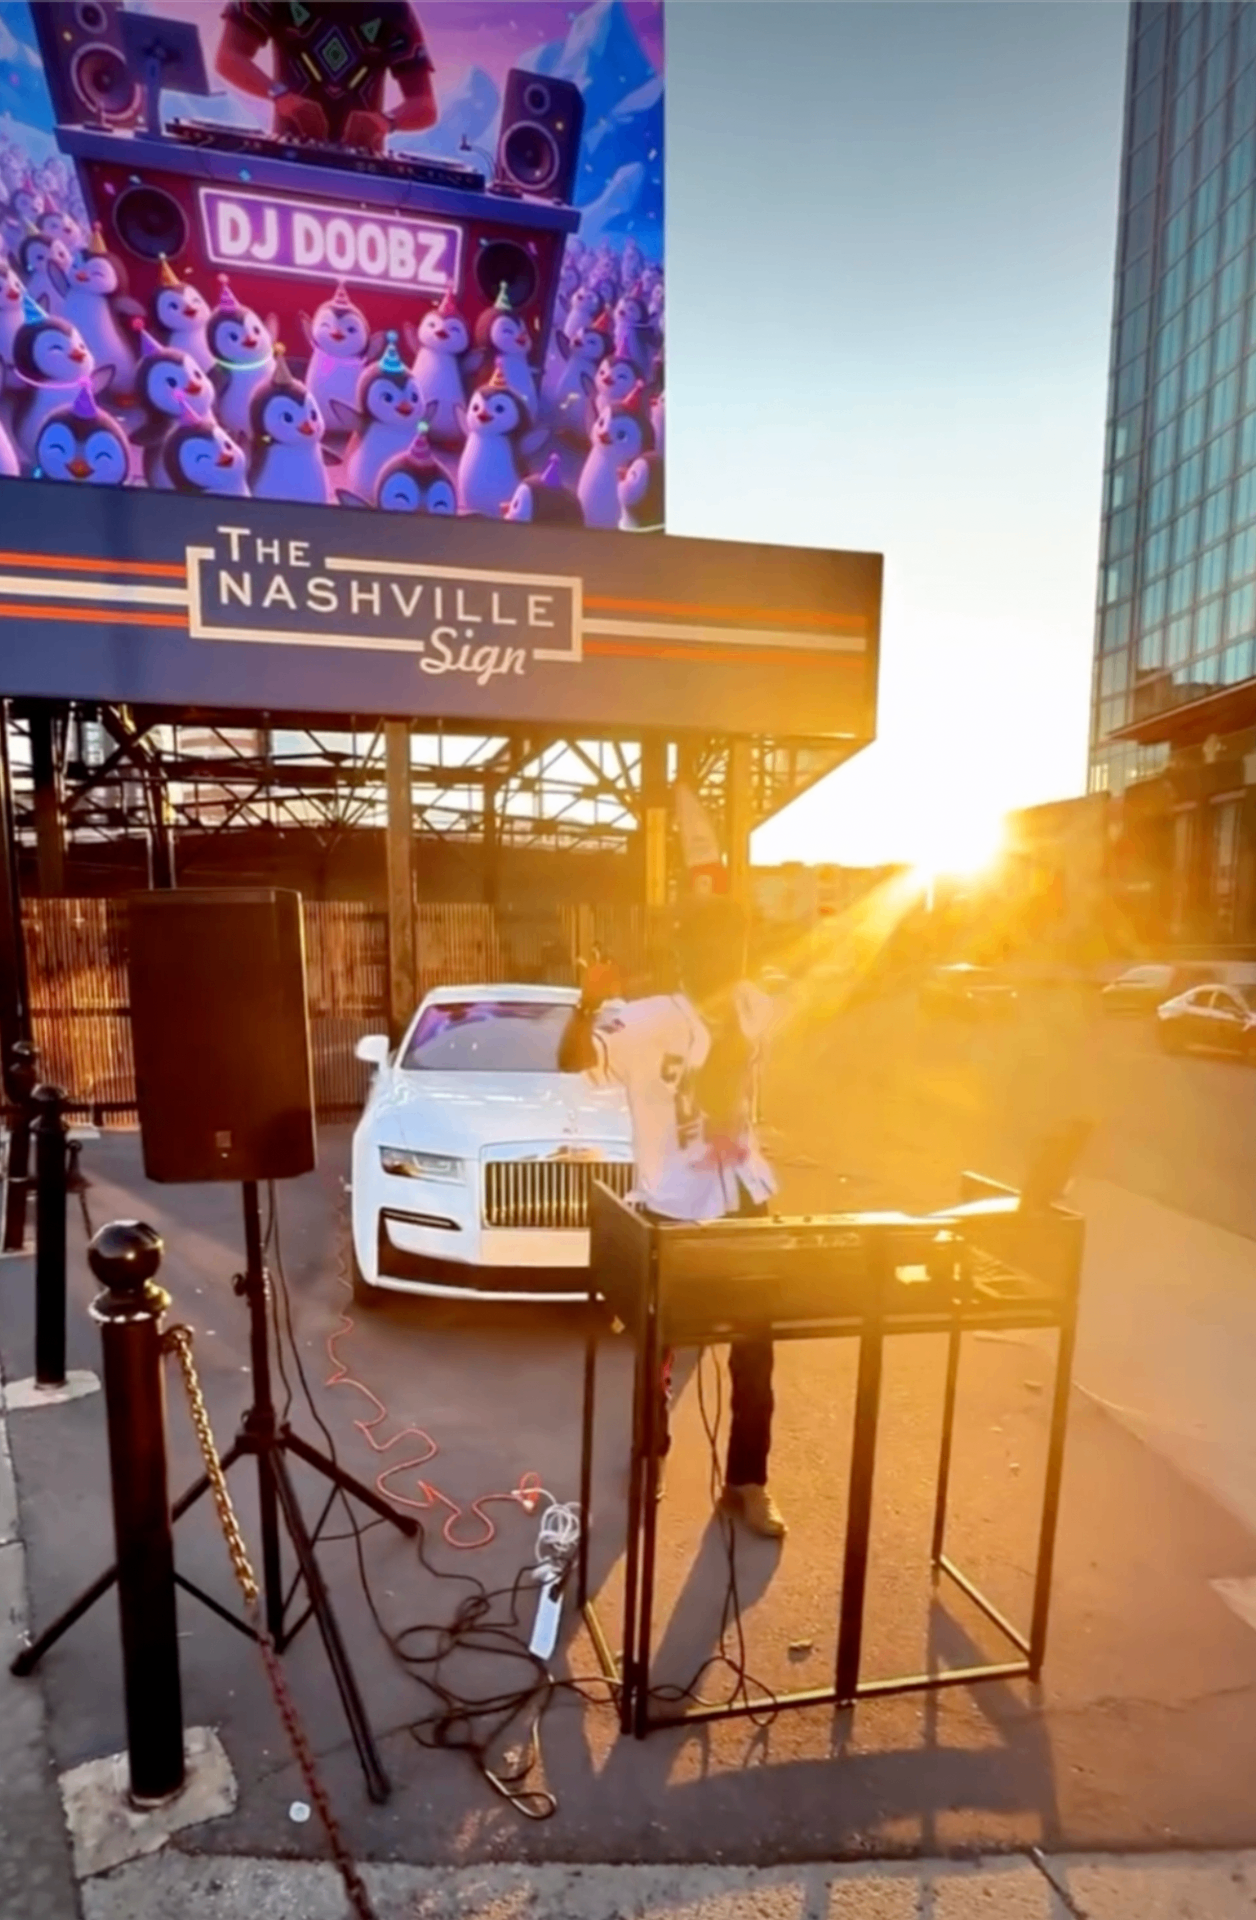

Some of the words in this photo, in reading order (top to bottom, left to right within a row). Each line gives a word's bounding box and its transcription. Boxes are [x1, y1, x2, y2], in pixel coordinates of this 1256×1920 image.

[217, 202, 279, 260] DJ
[293, 212, 448, 285] DOOBZ
[219, 570, 554, 628] NASHVILLE
[419, 626, 526, 686] Sign
